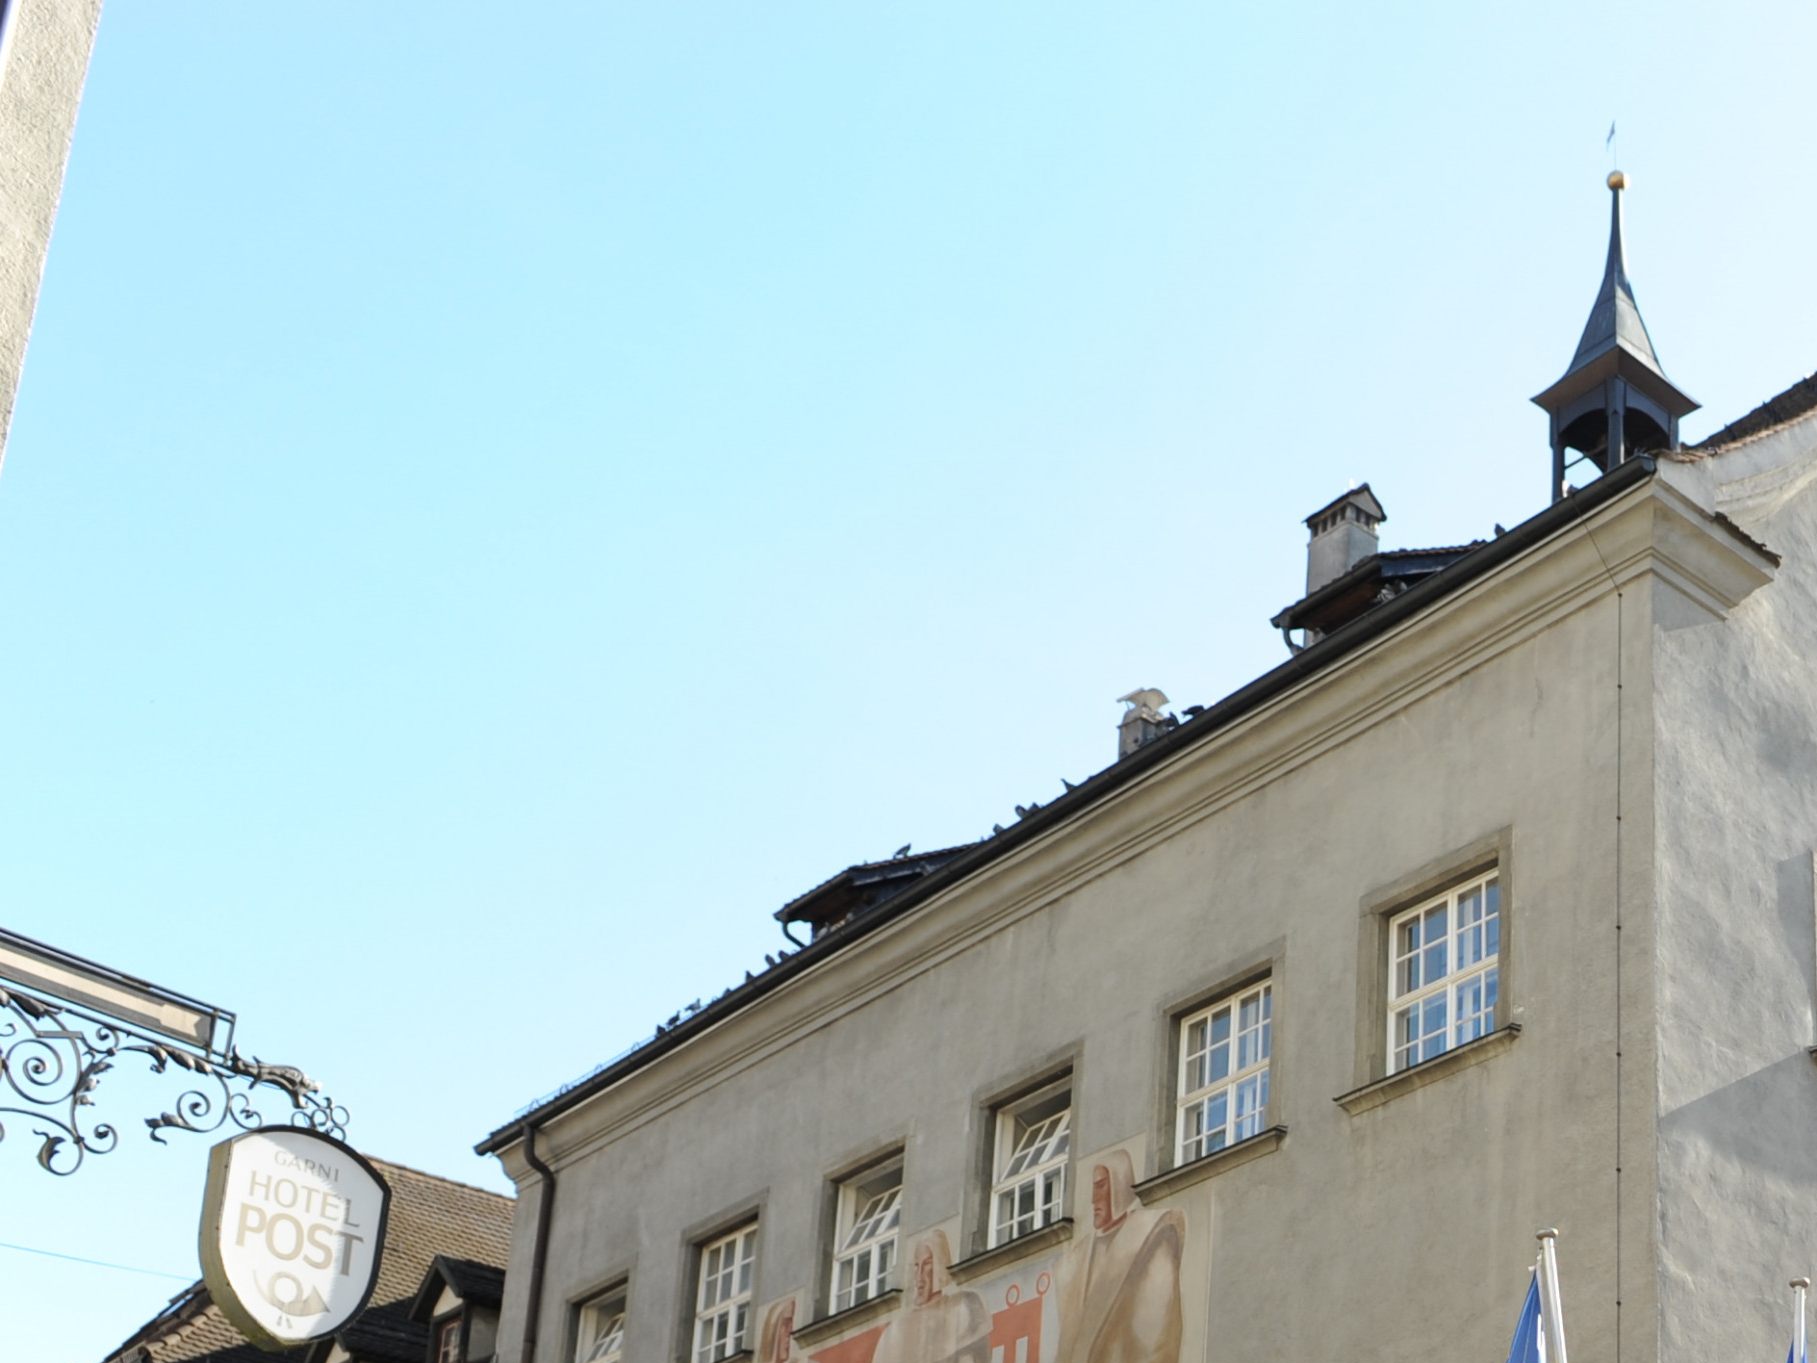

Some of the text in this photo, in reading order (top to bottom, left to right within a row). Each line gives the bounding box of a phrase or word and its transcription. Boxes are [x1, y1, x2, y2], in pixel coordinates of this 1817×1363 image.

[274, 1150, 339, 1182] GARNI
[249, 1170, 360, 1228] HOTEL
[235, 1202, 364, 1276] POST
